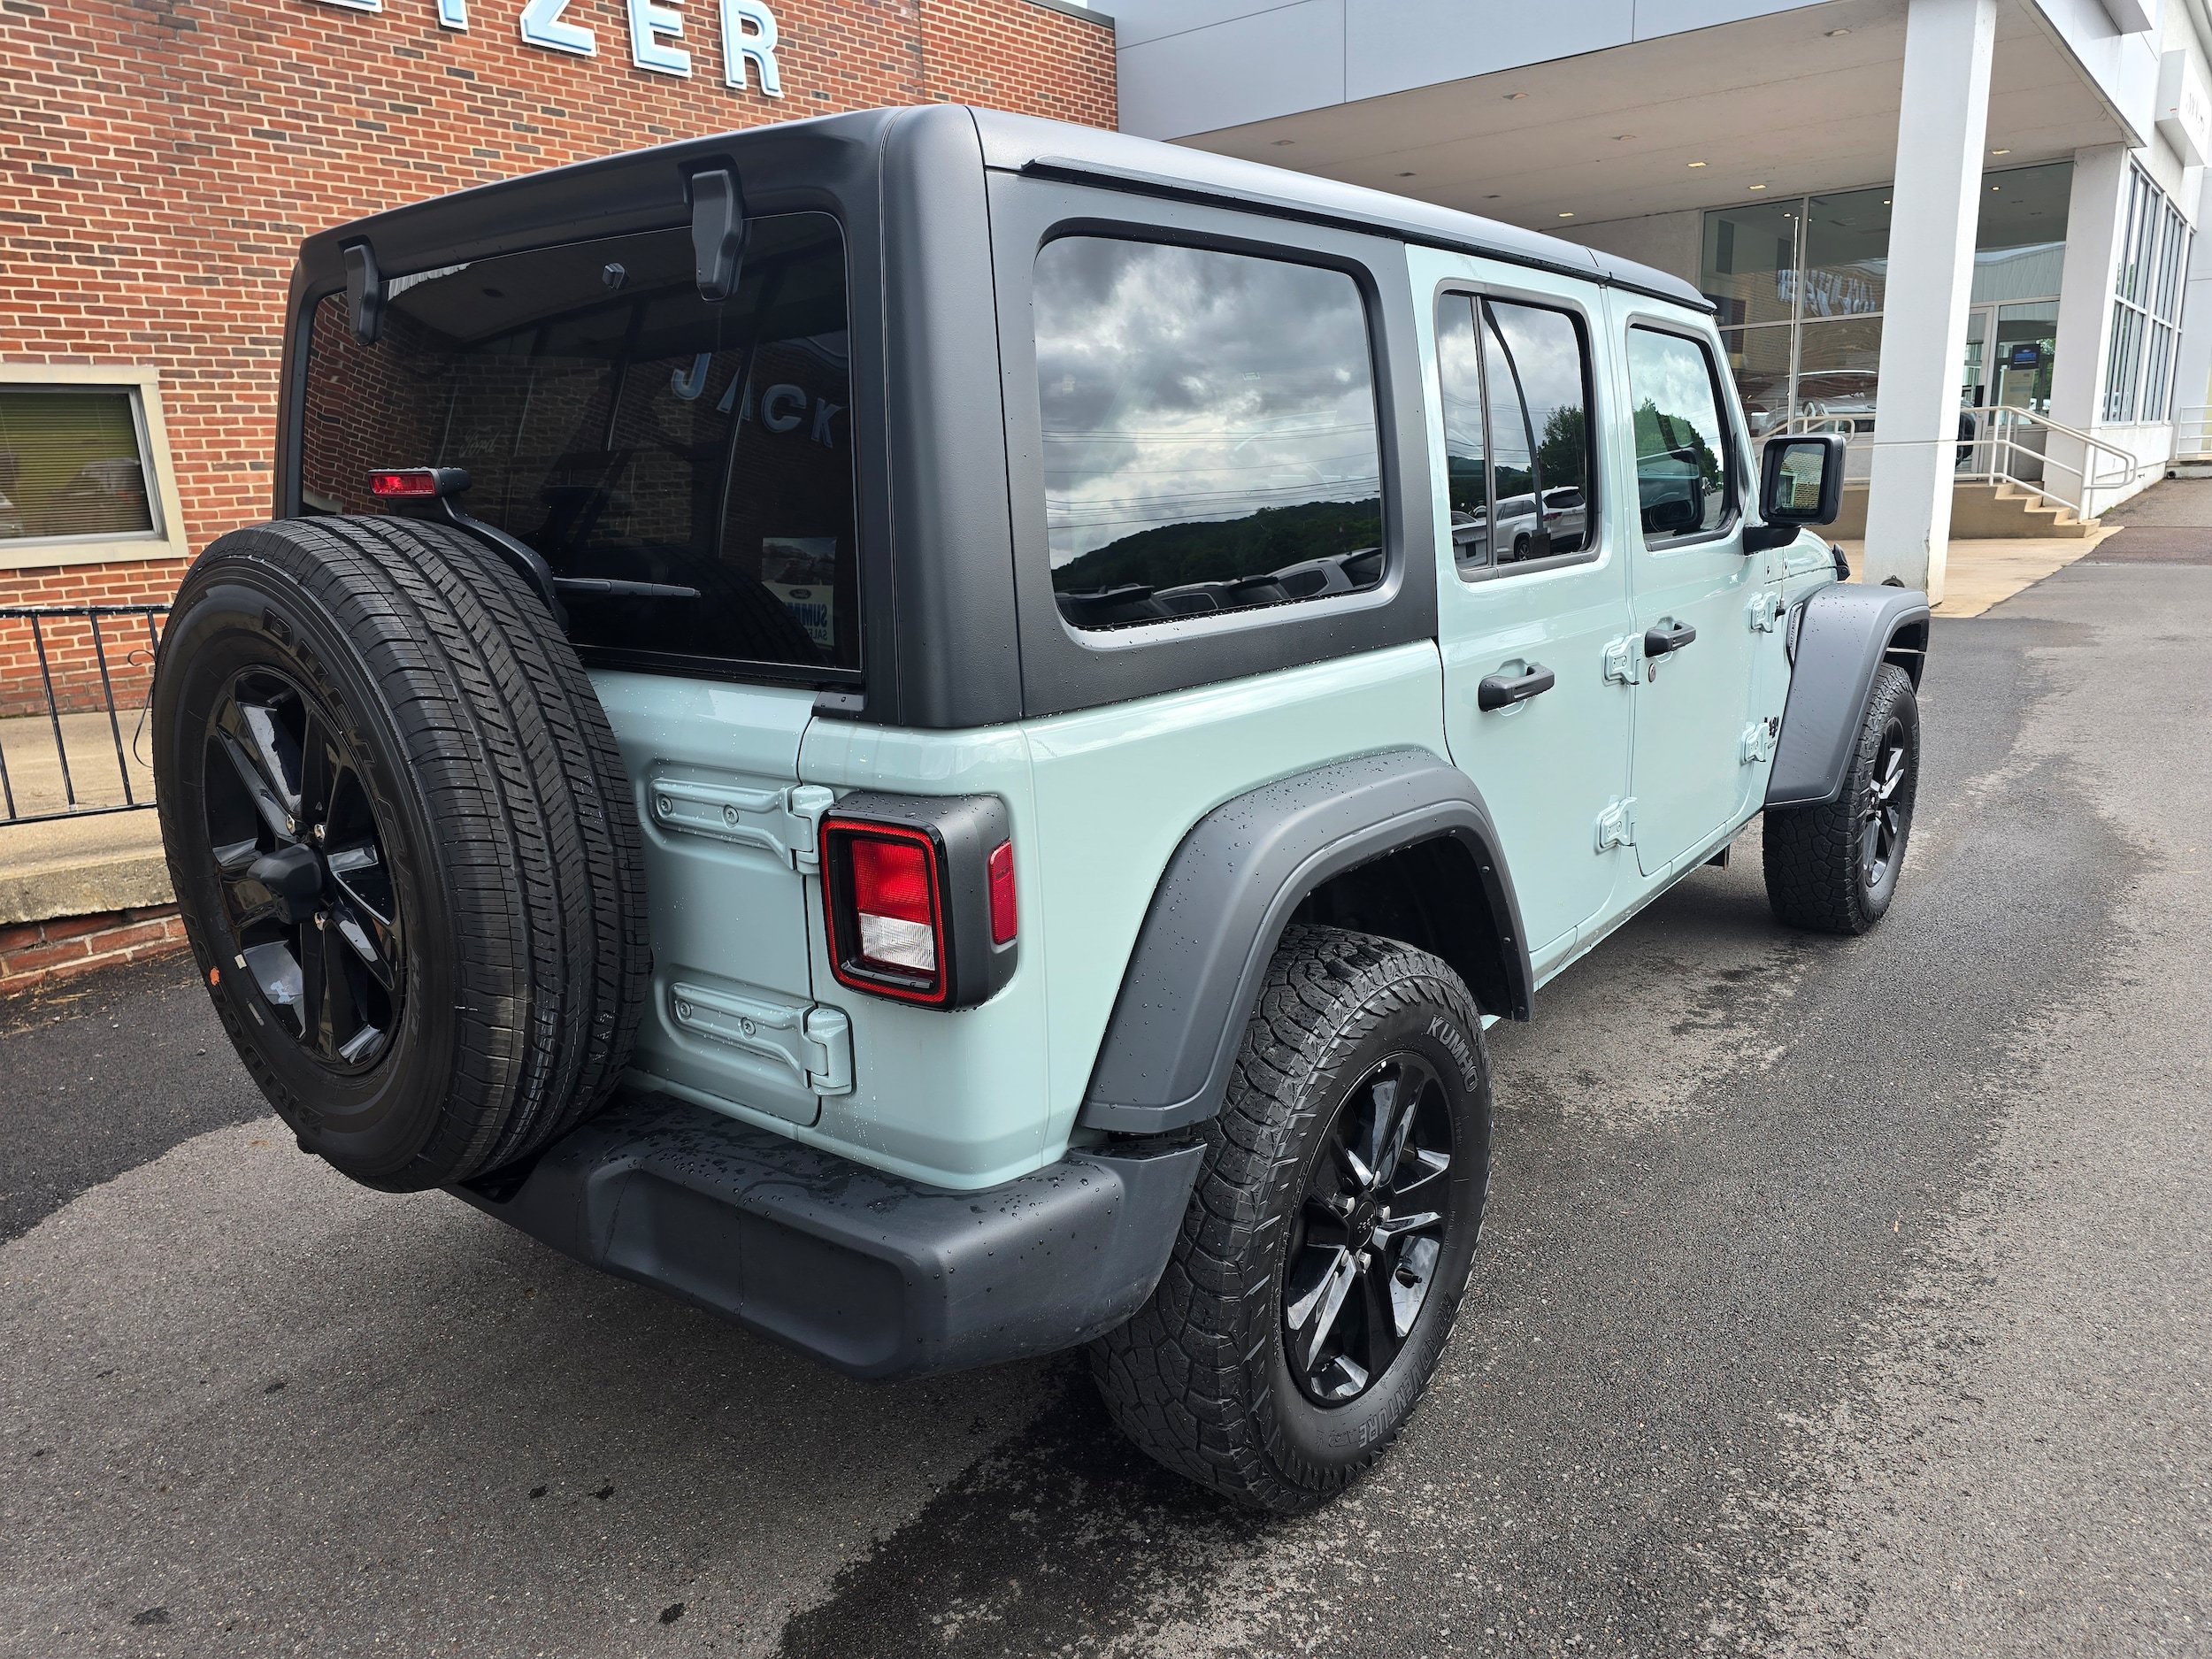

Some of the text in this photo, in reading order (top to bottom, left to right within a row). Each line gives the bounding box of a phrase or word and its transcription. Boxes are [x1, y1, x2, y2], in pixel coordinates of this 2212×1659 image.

[315, 0, 784, 98] ZER
[458, 430, 502, 458] Ford
[671, 351, 842, 449] JACK
[1425, 1013, 1479, 1093] KUMHO
[1358, 1289, 1458, 1449] ROADVENTURE
